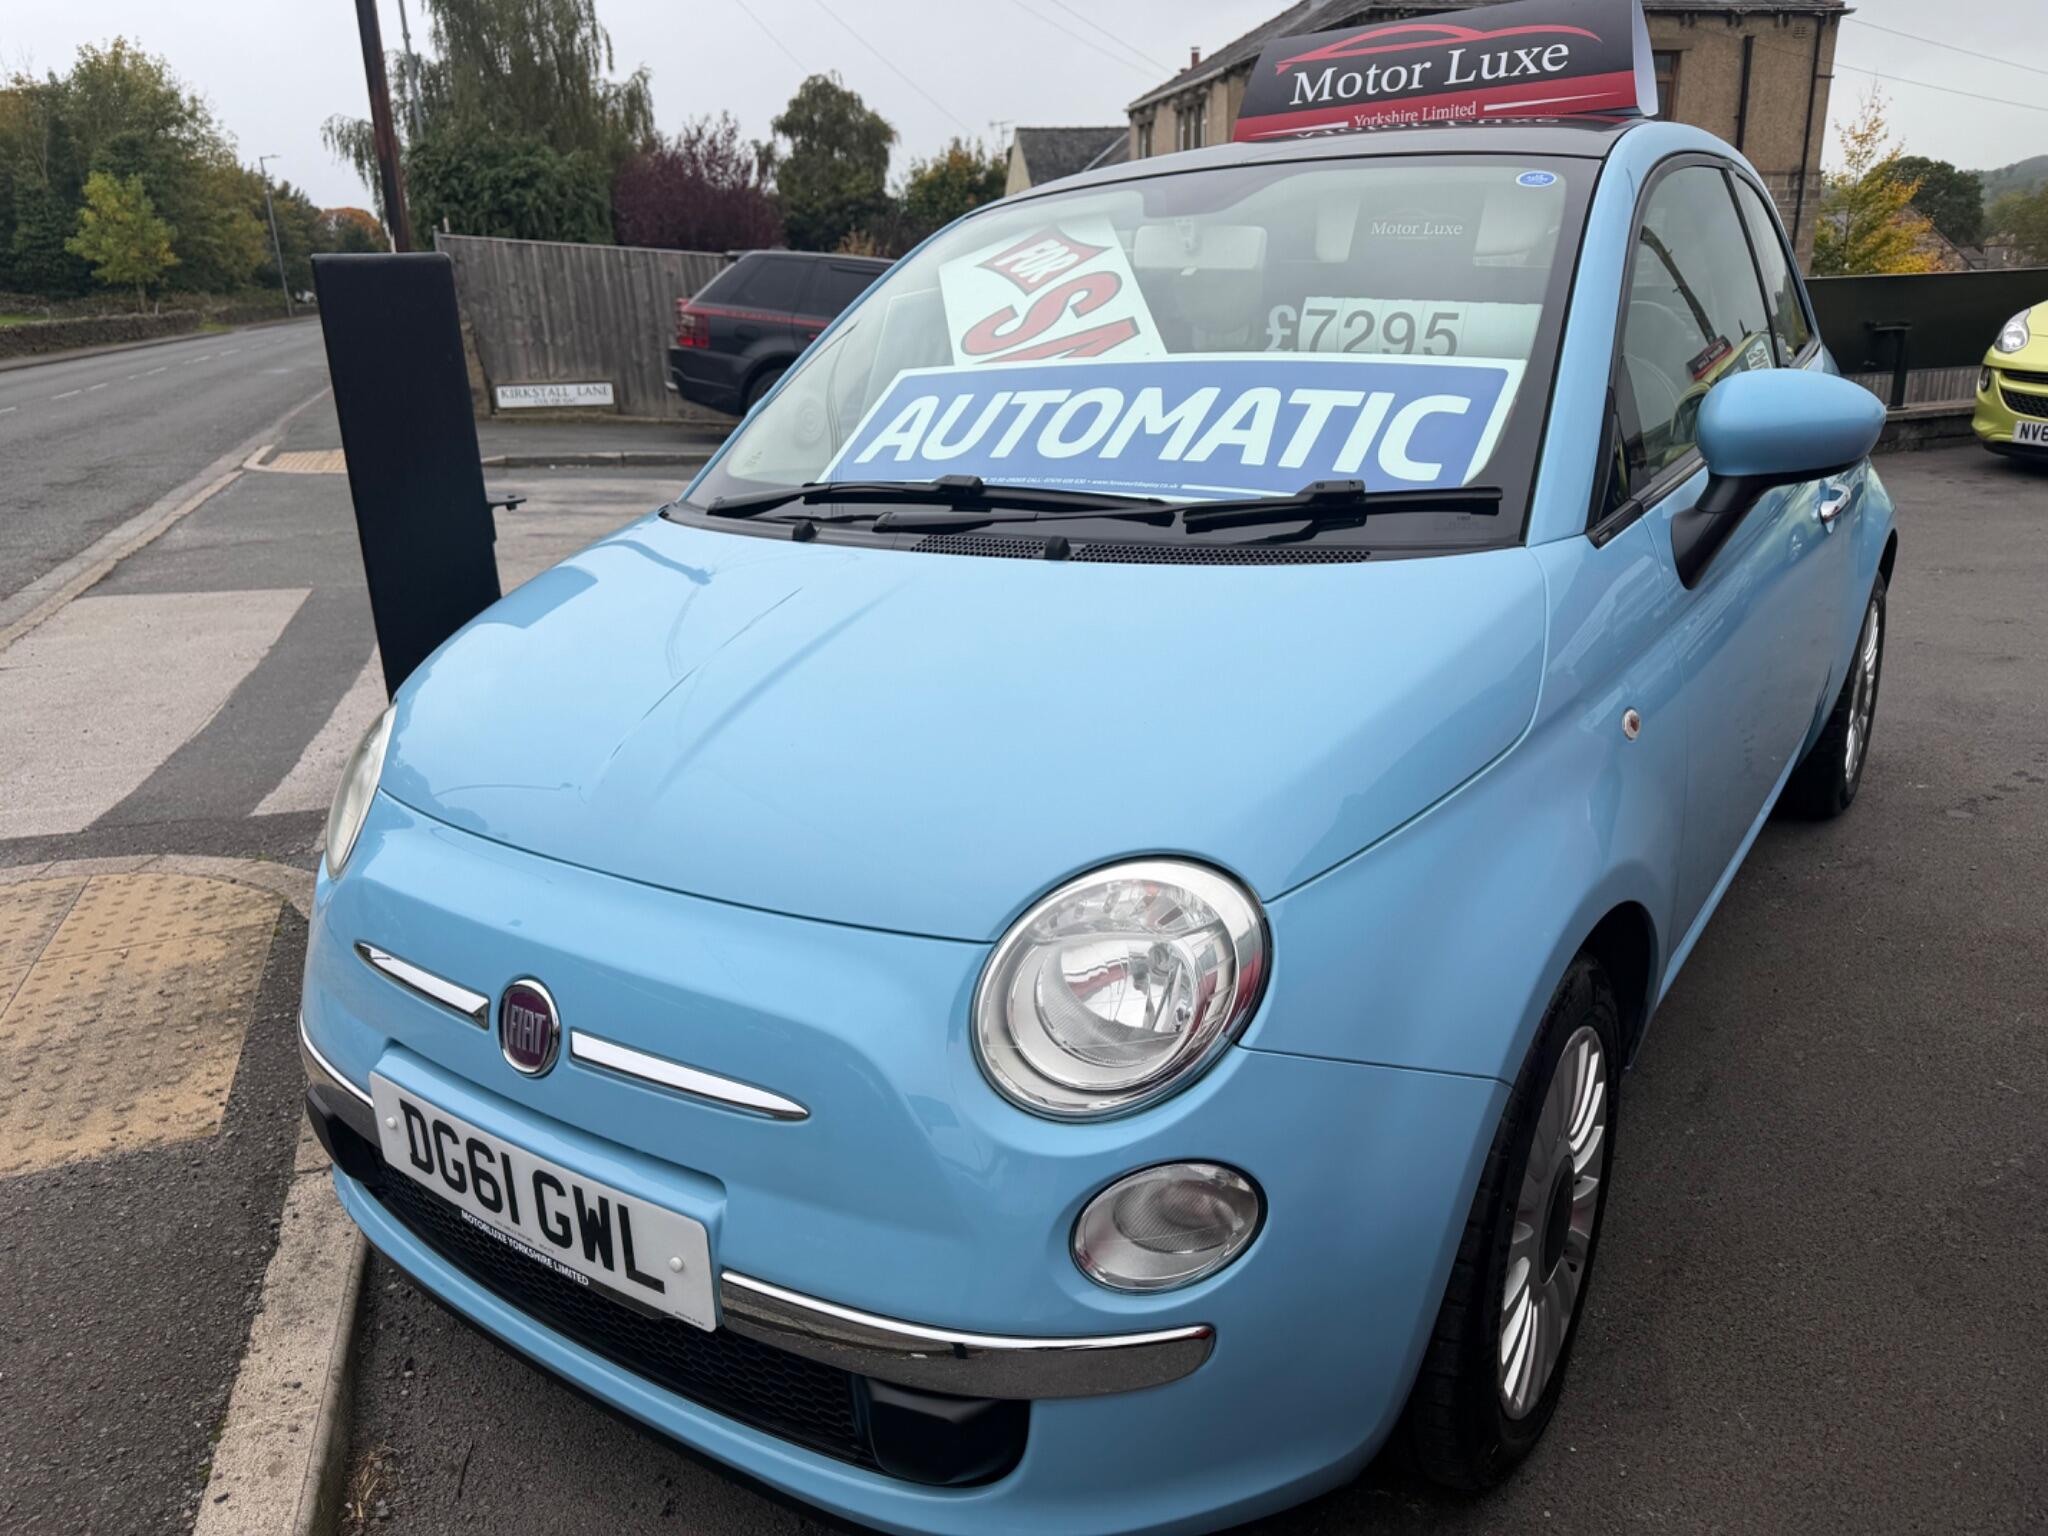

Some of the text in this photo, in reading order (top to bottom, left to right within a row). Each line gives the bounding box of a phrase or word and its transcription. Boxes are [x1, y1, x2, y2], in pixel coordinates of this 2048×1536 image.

[1289, 43, 1570, 106] Motor Luxe
[1354, 101, 1477, 126] Yorkshire Limited
[1371, 221, 1464, 235] Motor Luxe
[1264, 304, 1460, 356] £7295
[500, 385, 609, 400] KIRKSTALL LANE
[854, 386, 1472, 481] AUTOMATIC
[508, 1003, 547, 1056] FIAT
[399, 1097, 666, 1295] DG61 GWL
[507, 1236, 553, 1269] YORKSHIRE
[553, 1259, 590, 1287] LIMITED
